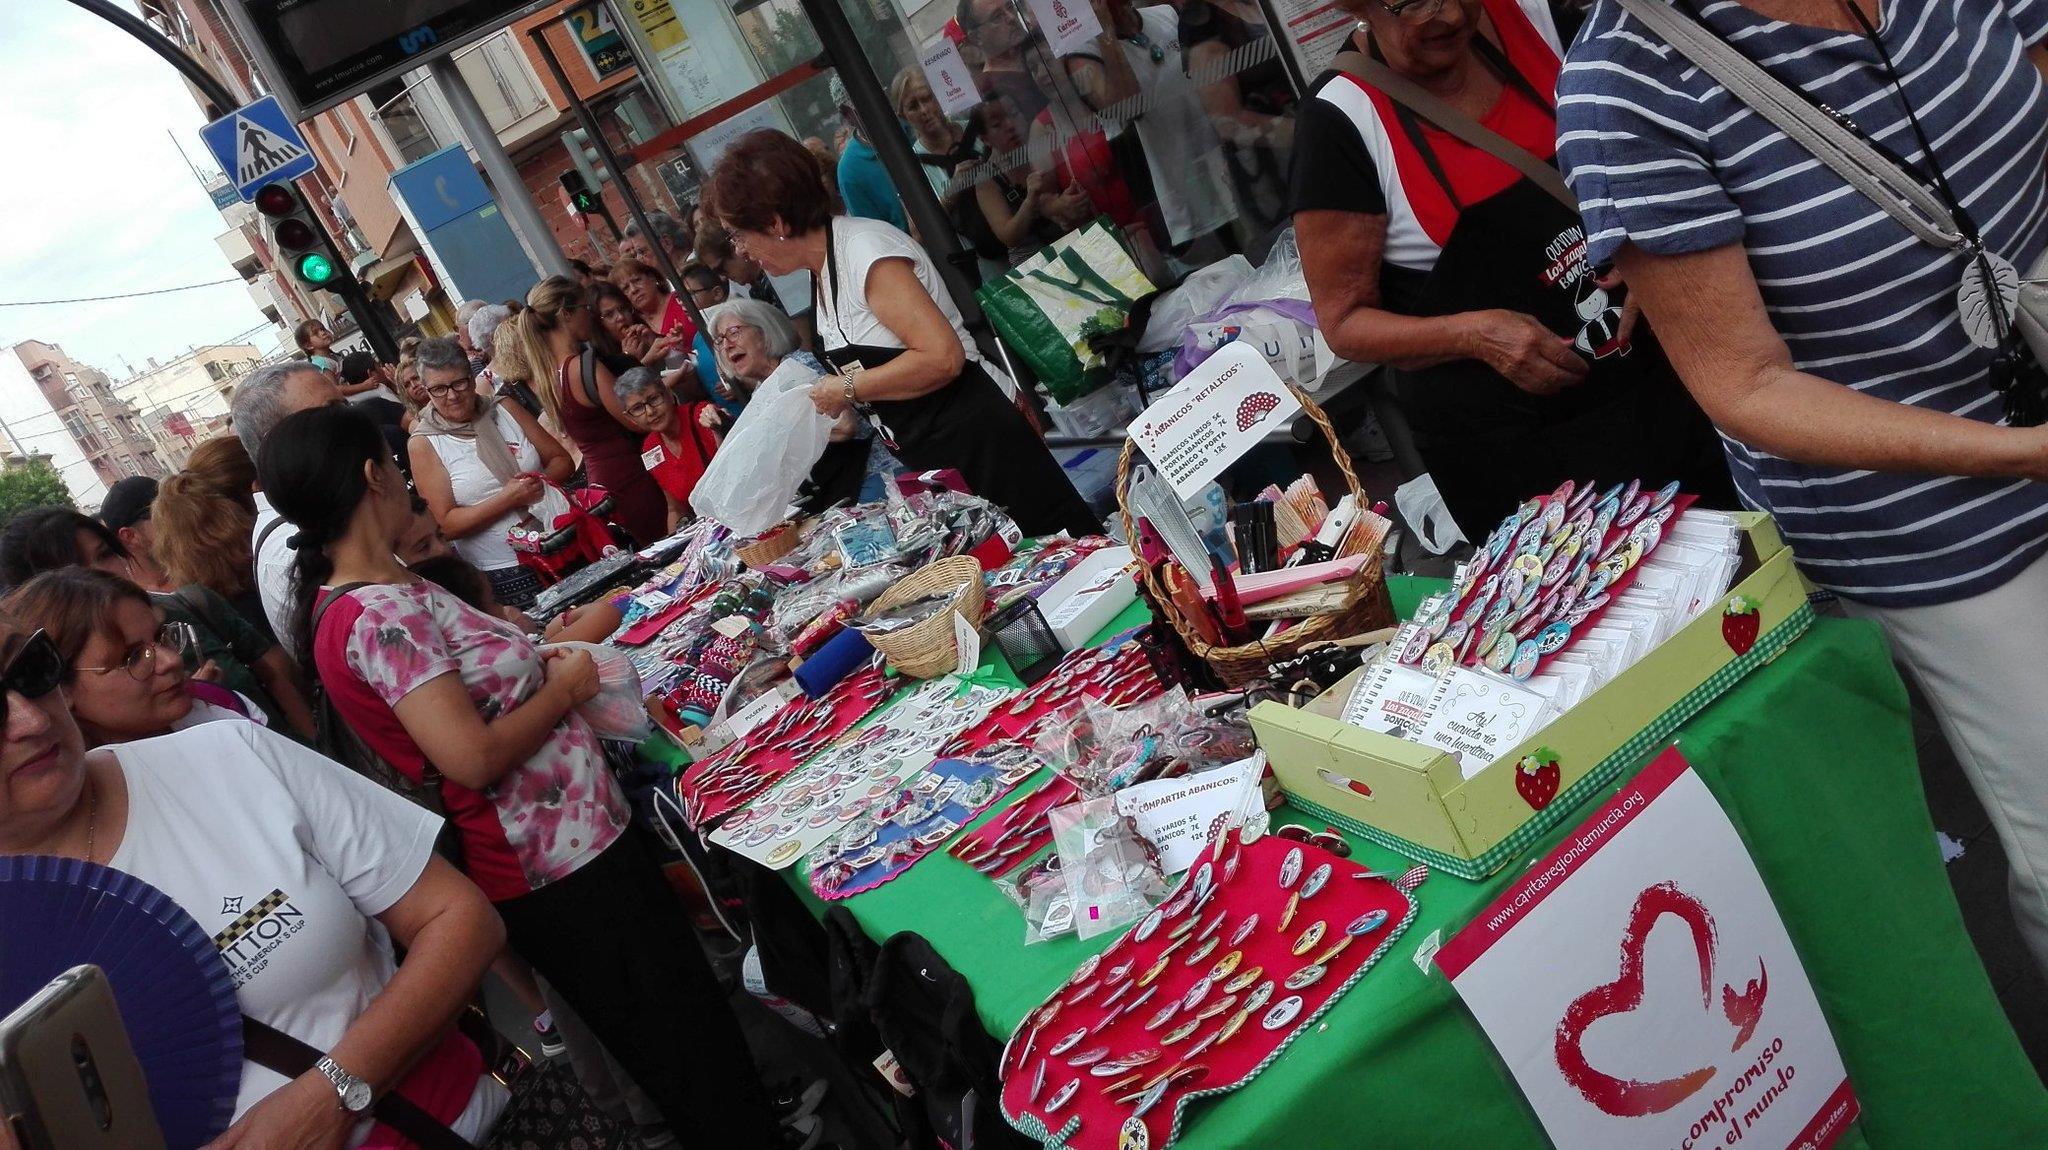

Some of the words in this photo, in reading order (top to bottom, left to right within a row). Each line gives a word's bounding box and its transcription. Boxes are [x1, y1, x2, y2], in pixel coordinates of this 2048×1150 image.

[1154, 402, 1194, 437] ABANICOS
[1159, 438, 1189, 465] ABANICOS
[1189, 420, 1212, 442] VARIOS
[1212, 411, 1222, 423] 5€
[1164, 453, 1184, 471] PORTA
[1184, 430, 1215, 457] ABANICOS
[1218, 418, 1228, 429] 7€
[1170, 453, 1199, 478] ABANICO
[1204, 430, 1228, 451] PORTA
[1175, 457, 1209, 486] ABANICOS
[1213, 442, 1228, 455] 12€
[745, 704, 768, 721] PULSERAS
[1446, 721, 1482, 740] cuando
[1138, 791, 1186, 813] COMPARTIR
[1188, 777, 1239, 796] ABANICOS:
[1157, 829, 1185, 844] BANICOS
[1161, 818, 1187, 833] VARIOS
[1189, 814, 1197, 823] 5€
[1487, 789, 1646, 932] www.caritasregiondemurcia.org
[220, 902, 303, 969] ITTON
[230, 965, 248, 980] THE
[290, 919, 305, 934] CUP
[252, 959, 269, 975] CUP
[1682, 1037, 1783, 1150] compromiso
[1726, 1117, 1742, 1144] el
[1744, 1065, 1795, 1128] mundo
